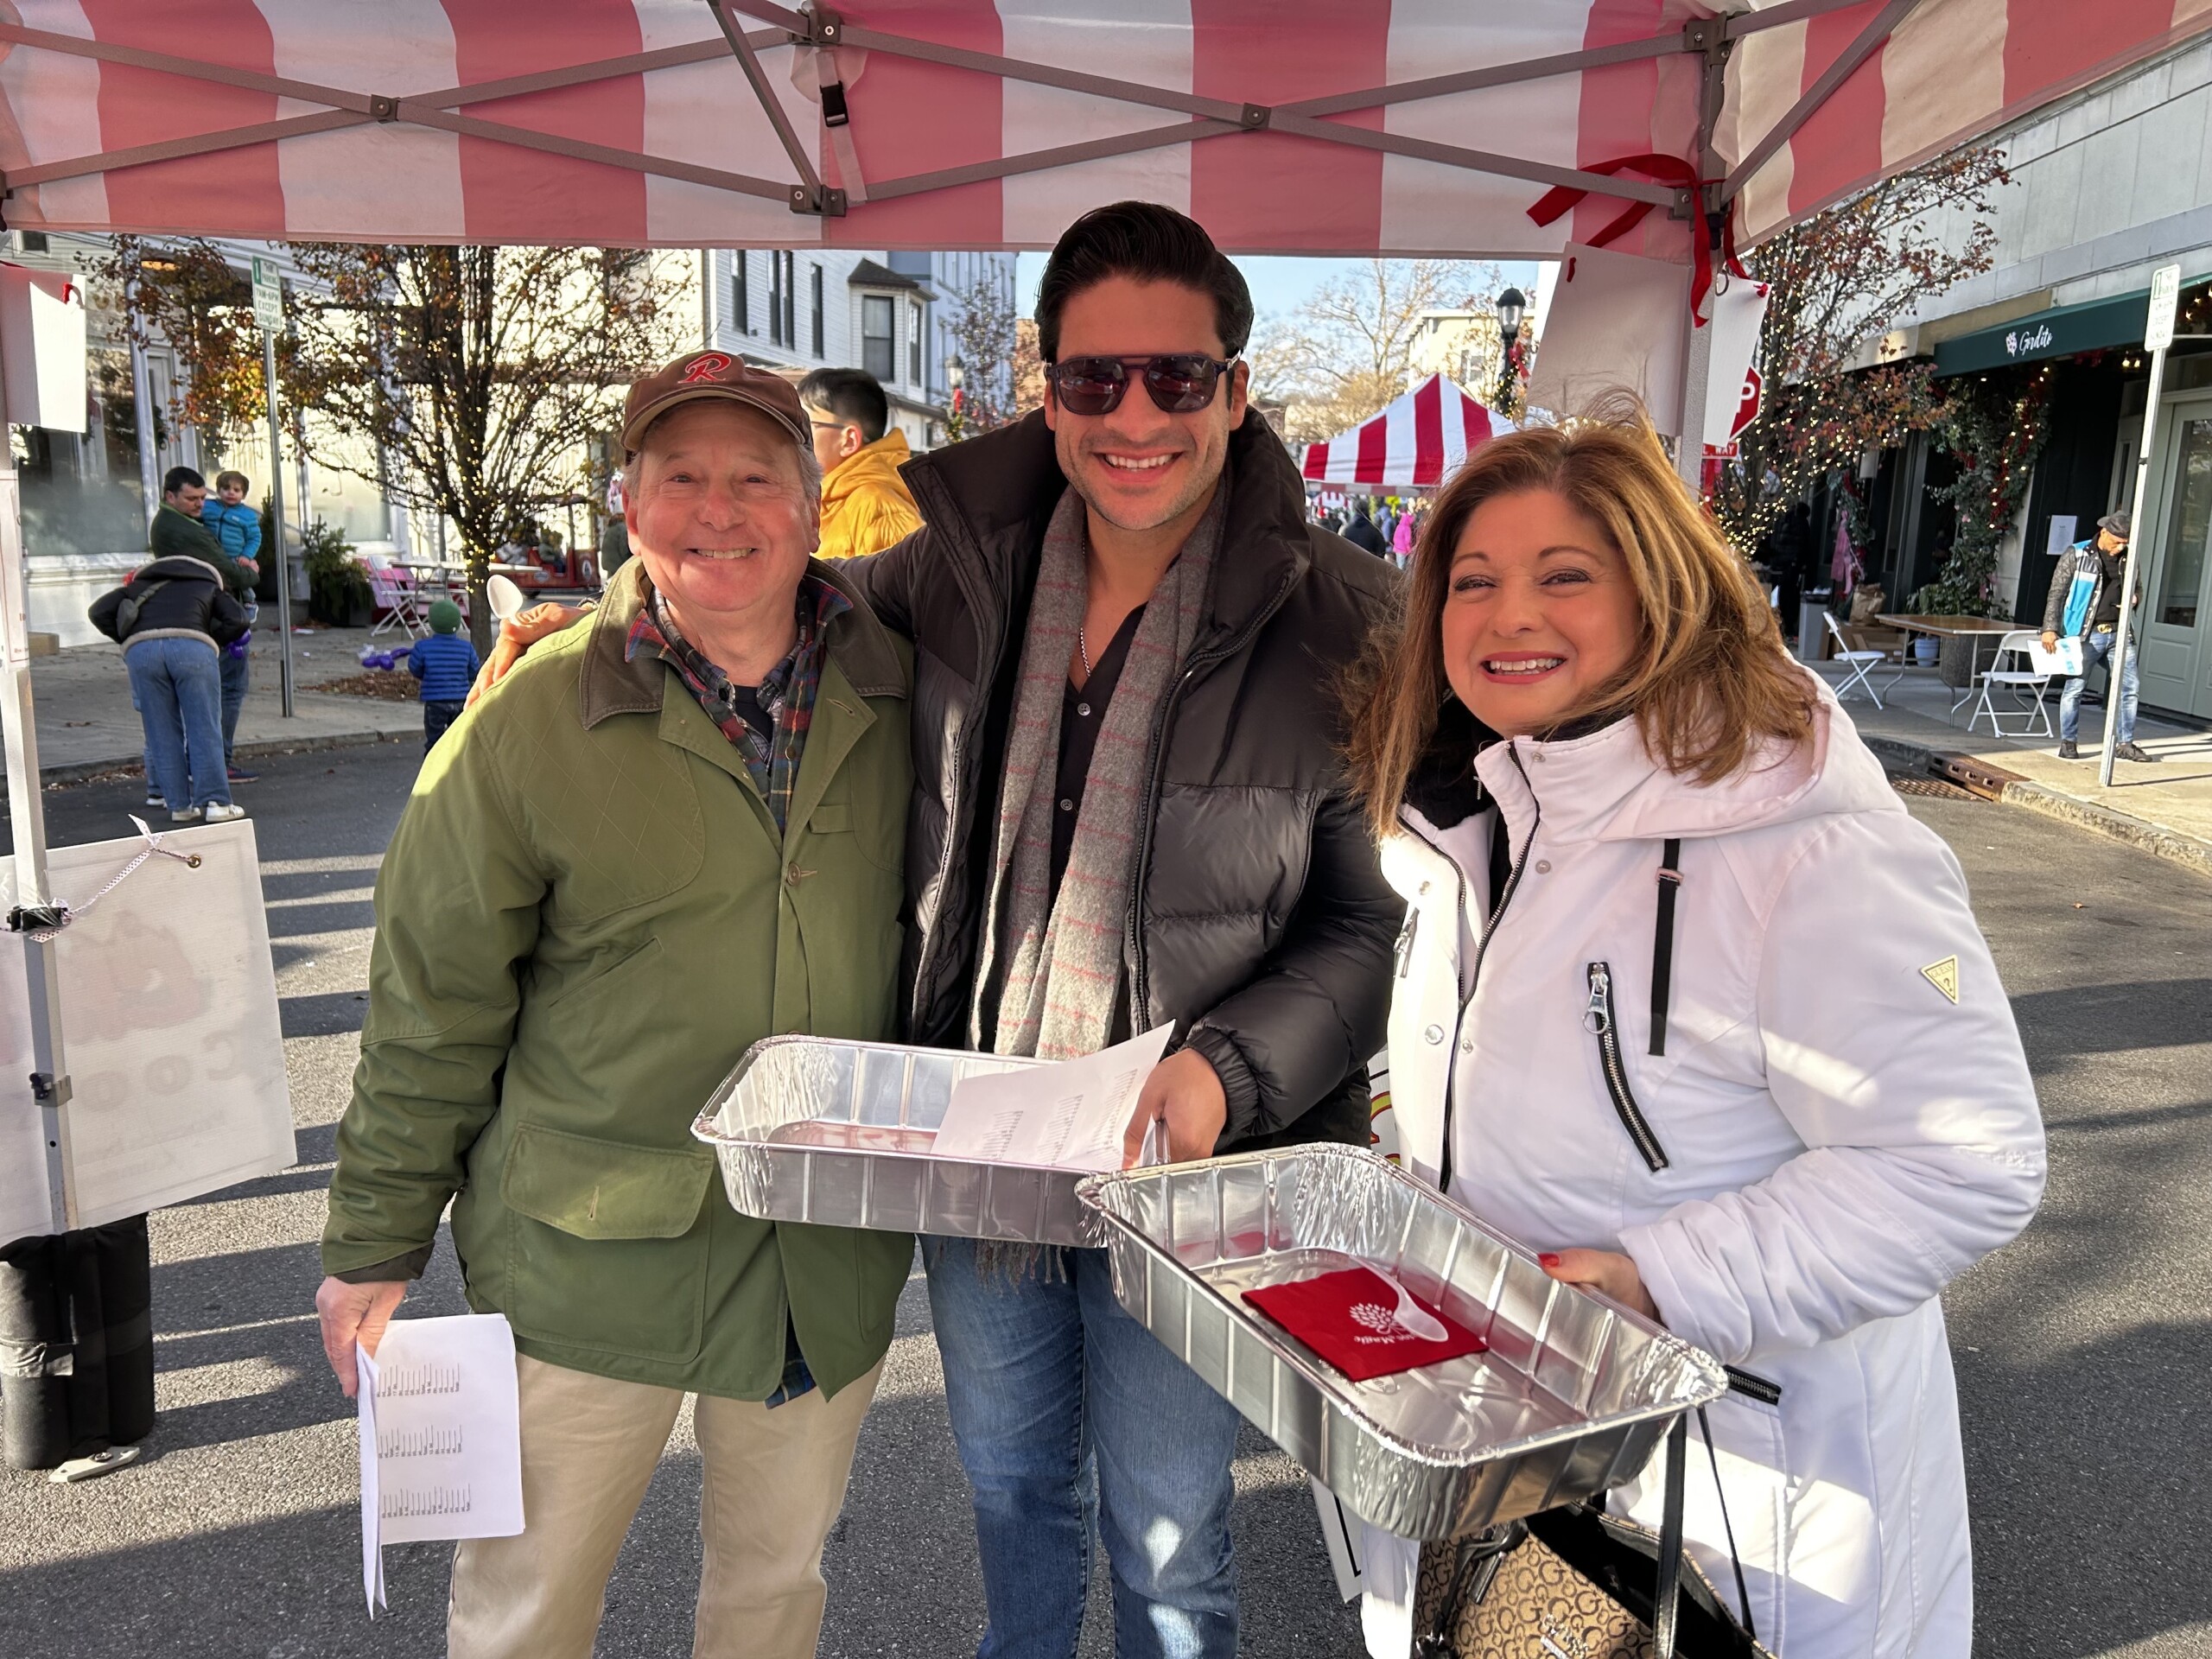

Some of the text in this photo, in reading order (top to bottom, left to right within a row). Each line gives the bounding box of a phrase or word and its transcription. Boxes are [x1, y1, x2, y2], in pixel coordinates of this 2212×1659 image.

[258, 300, 278, 313] EXCEPT
[258, 312, 279, 326] SUNDAY
[677, 353, 731, 384] R
[1715, 445, 1734, 455] WAY
[1931, 964, 1953, 978] GUESS
